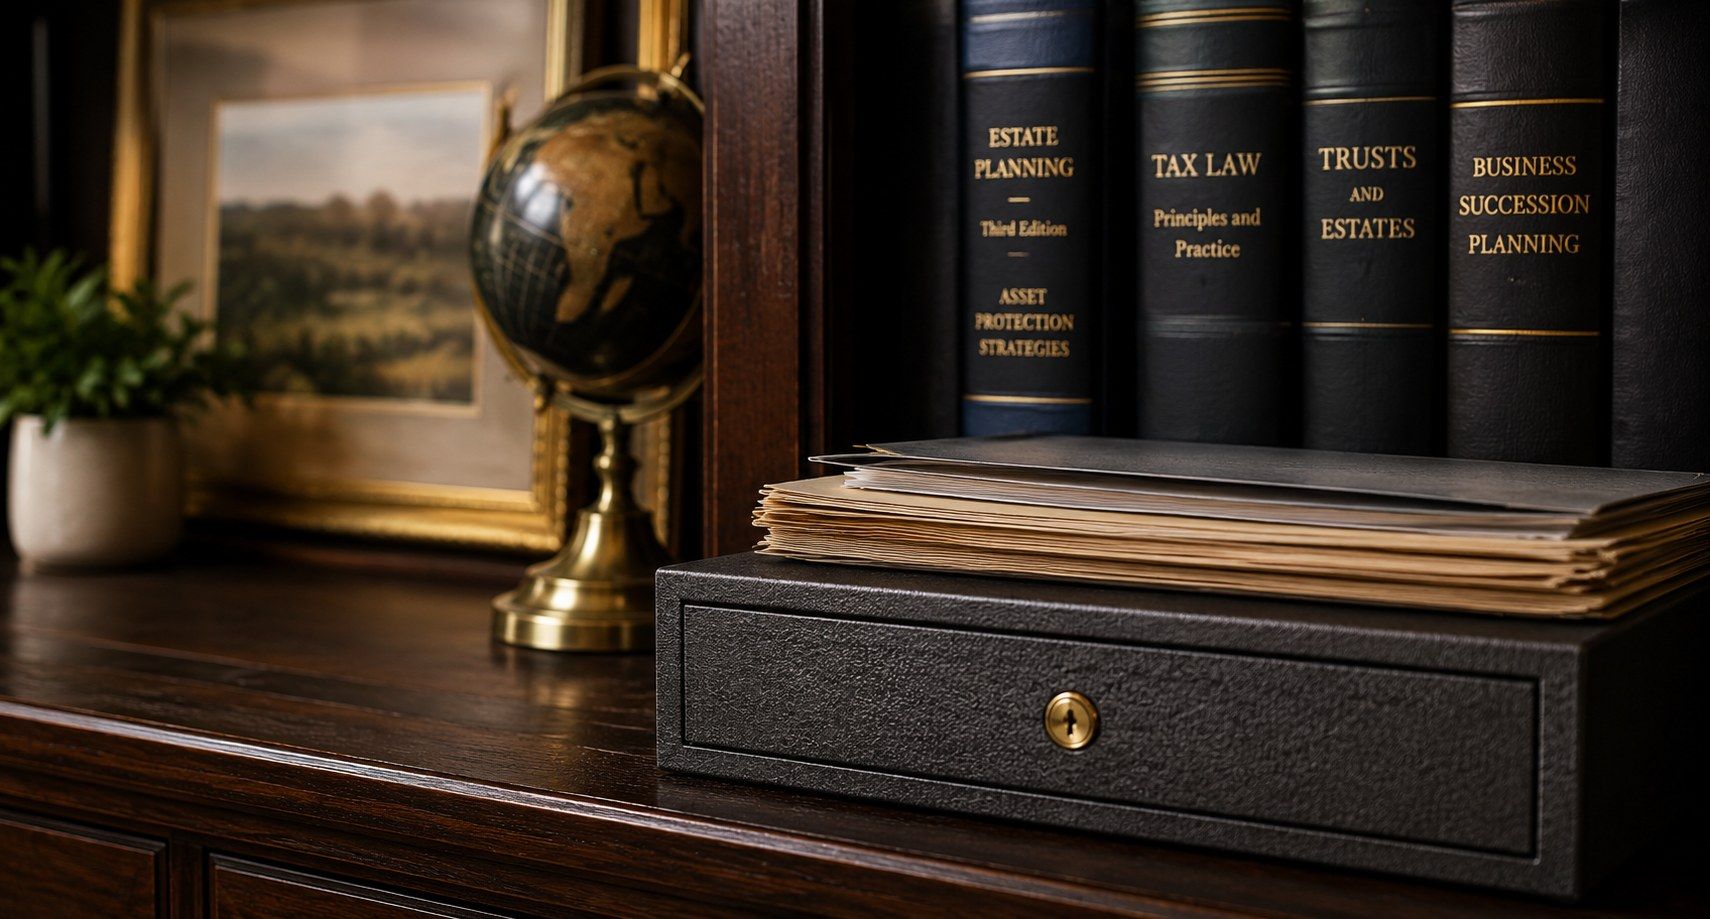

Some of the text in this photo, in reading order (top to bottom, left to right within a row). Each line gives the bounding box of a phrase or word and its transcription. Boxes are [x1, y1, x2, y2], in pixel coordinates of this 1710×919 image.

[988, 126, 1059, 149] ESTATE
[974, 158, 1074, 180] PLANNING
[1152, 153, 1261, 178] TAX LAW
[1319, 147, 1415, 171] TRUSTS
[1472, 157, 1576, 178] BUSINESS
[1350, 187, 1384, 202] AND
[1459, 195, 1589, 216] SUCCESSION
[980, 220, 1067, 237] Third Edition
[1153, 208, 1261, 231] Principles and
[1321, 218, 1415, 240] ESTATES
[1175, 240, 1241, 258] Practice
[1468, 234, 1579, 255] PLANNING
[999, 288, 1047, 305] ASSET
[975, 313, 1073, 331] PROTECTION
[978, 339, 1069, 357] STRATEGIES
